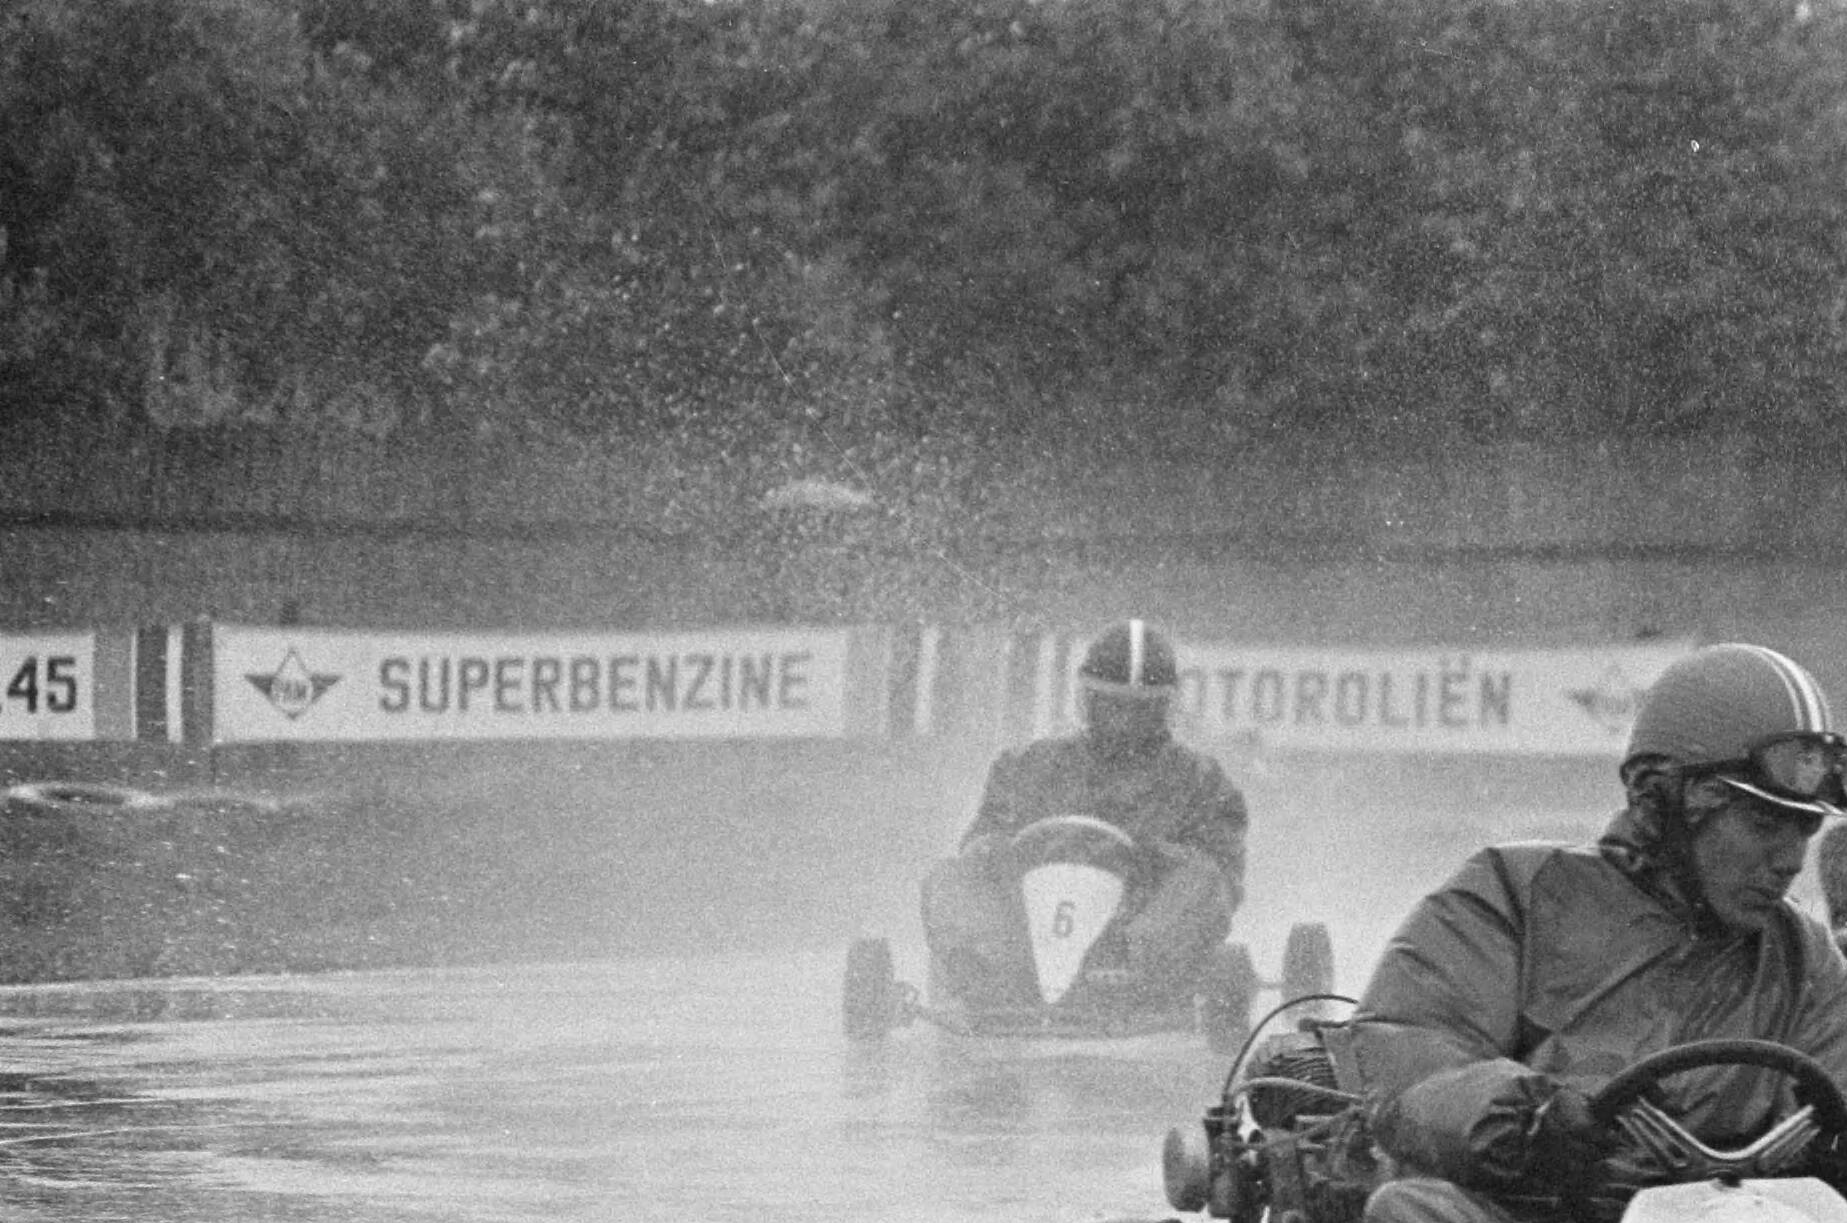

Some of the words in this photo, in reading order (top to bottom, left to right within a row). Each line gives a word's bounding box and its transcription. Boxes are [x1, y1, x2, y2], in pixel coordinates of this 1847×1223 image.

[379, 653, 810, 714] SUPERBENZINE
[1175, 655, 1512, 728] OTOROLIËN
[1052, 900, 1076, 940] 6
